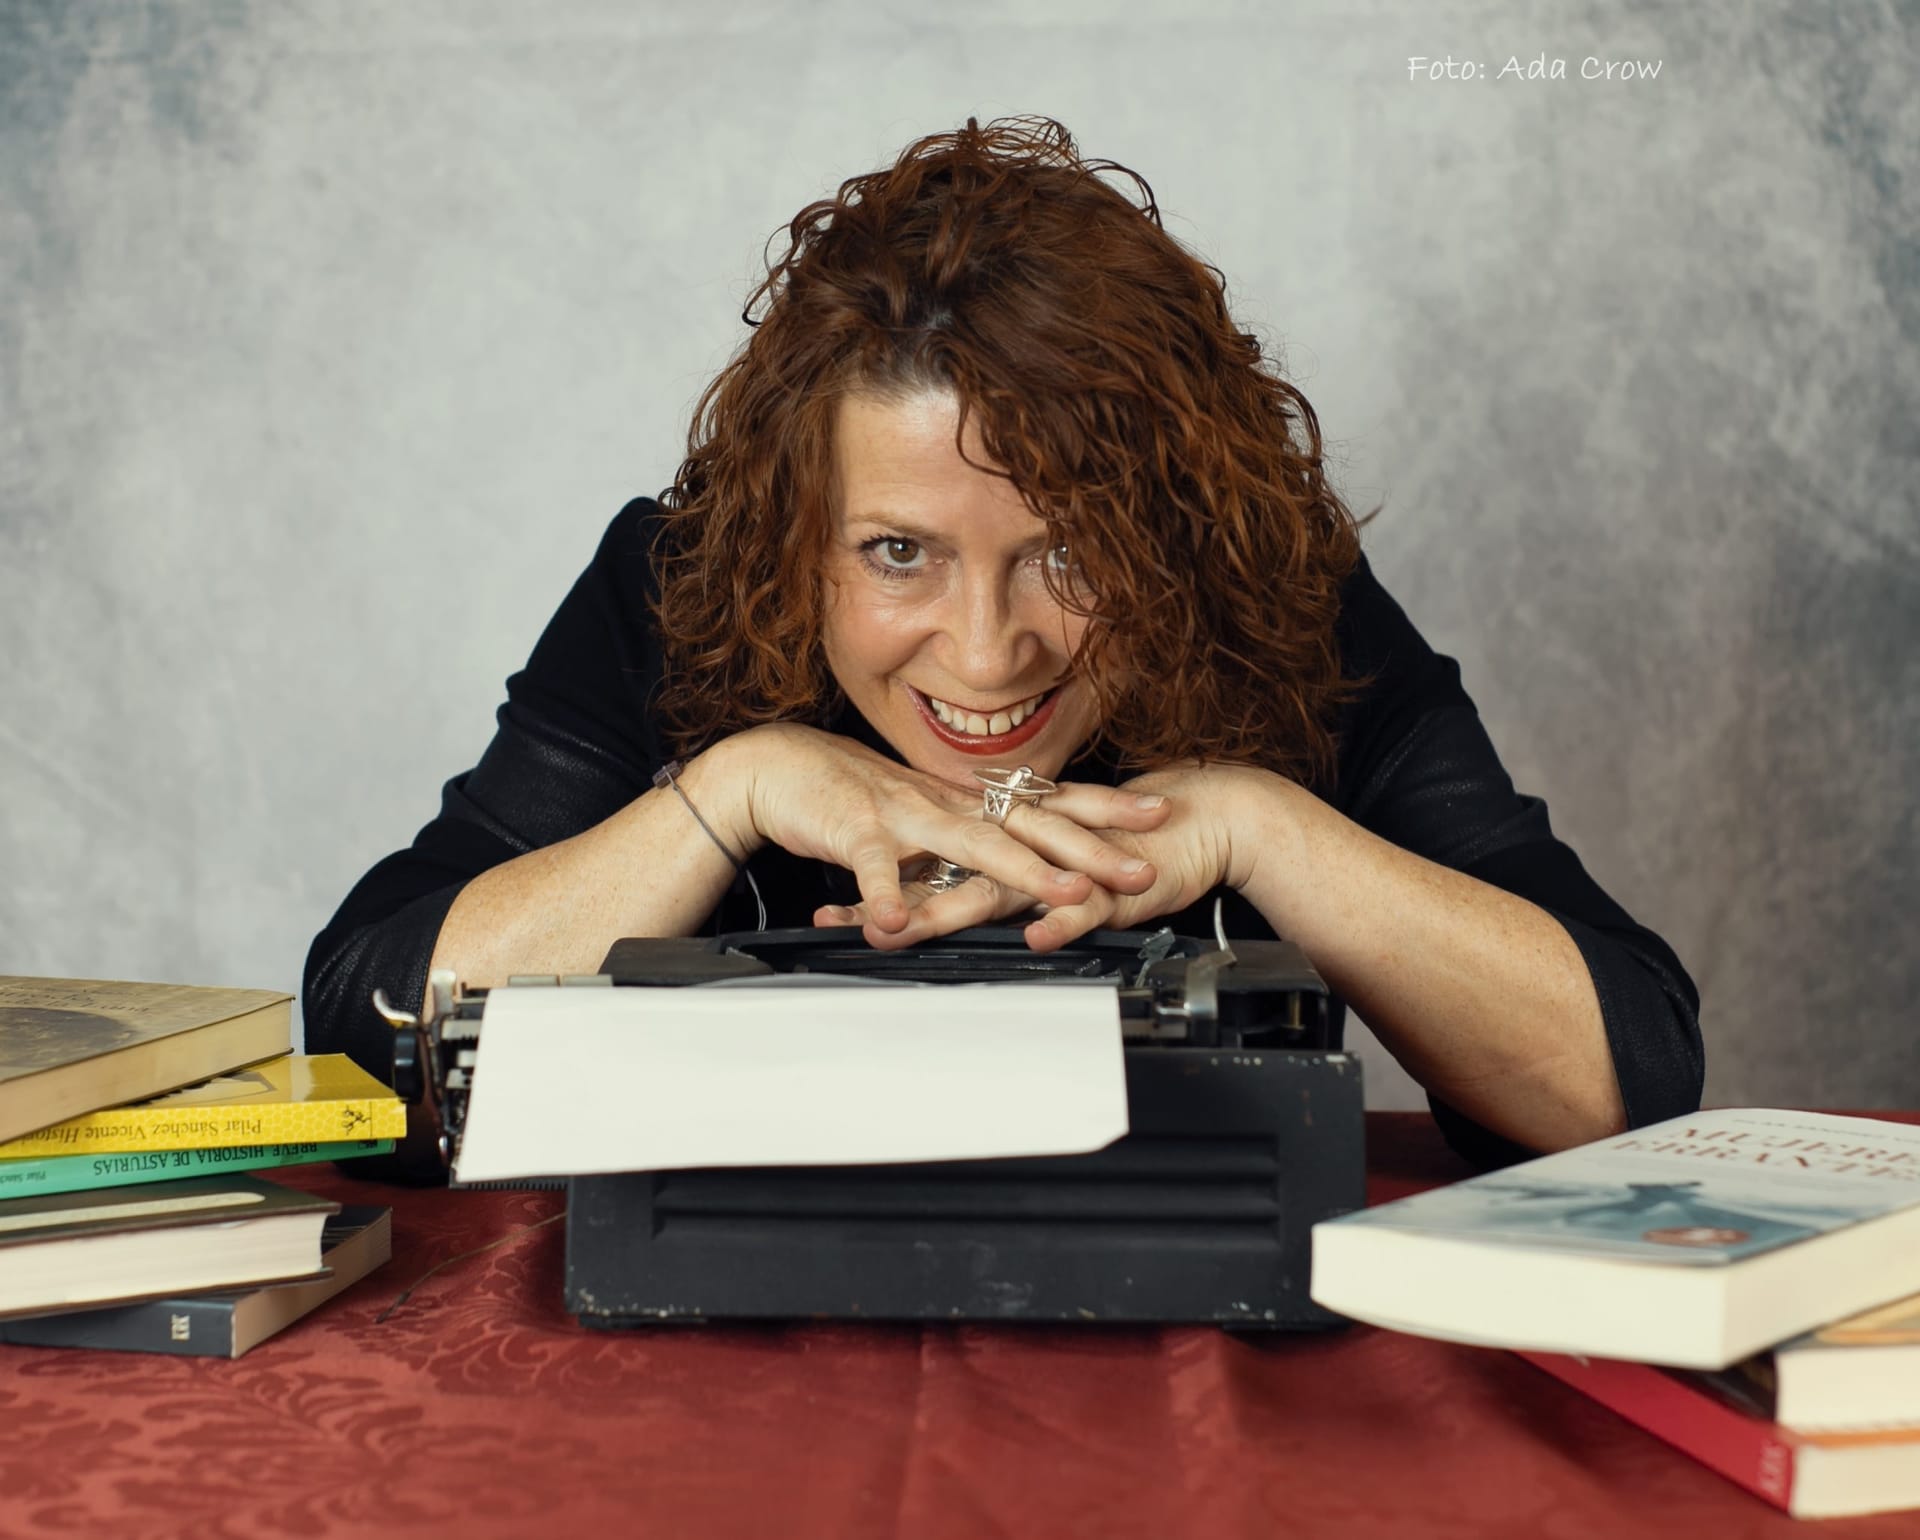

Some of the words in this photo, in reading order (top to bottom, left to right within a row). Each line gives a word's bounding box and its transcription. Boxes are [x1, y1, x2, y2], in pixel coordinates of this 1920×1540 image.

[85, 1125, 147, 1141] Vicente
[152, 1120, 219, 1138] Sánchez
[223, 1118, 262, 1135] Pilar
[172, 1150, 191, 1168] DE
[197, 1146, 265, 1164] HISTORIA
[272, 1142, 318, 1158] BREVE
[92, 1155, 169, 1177] ASTURIAS
